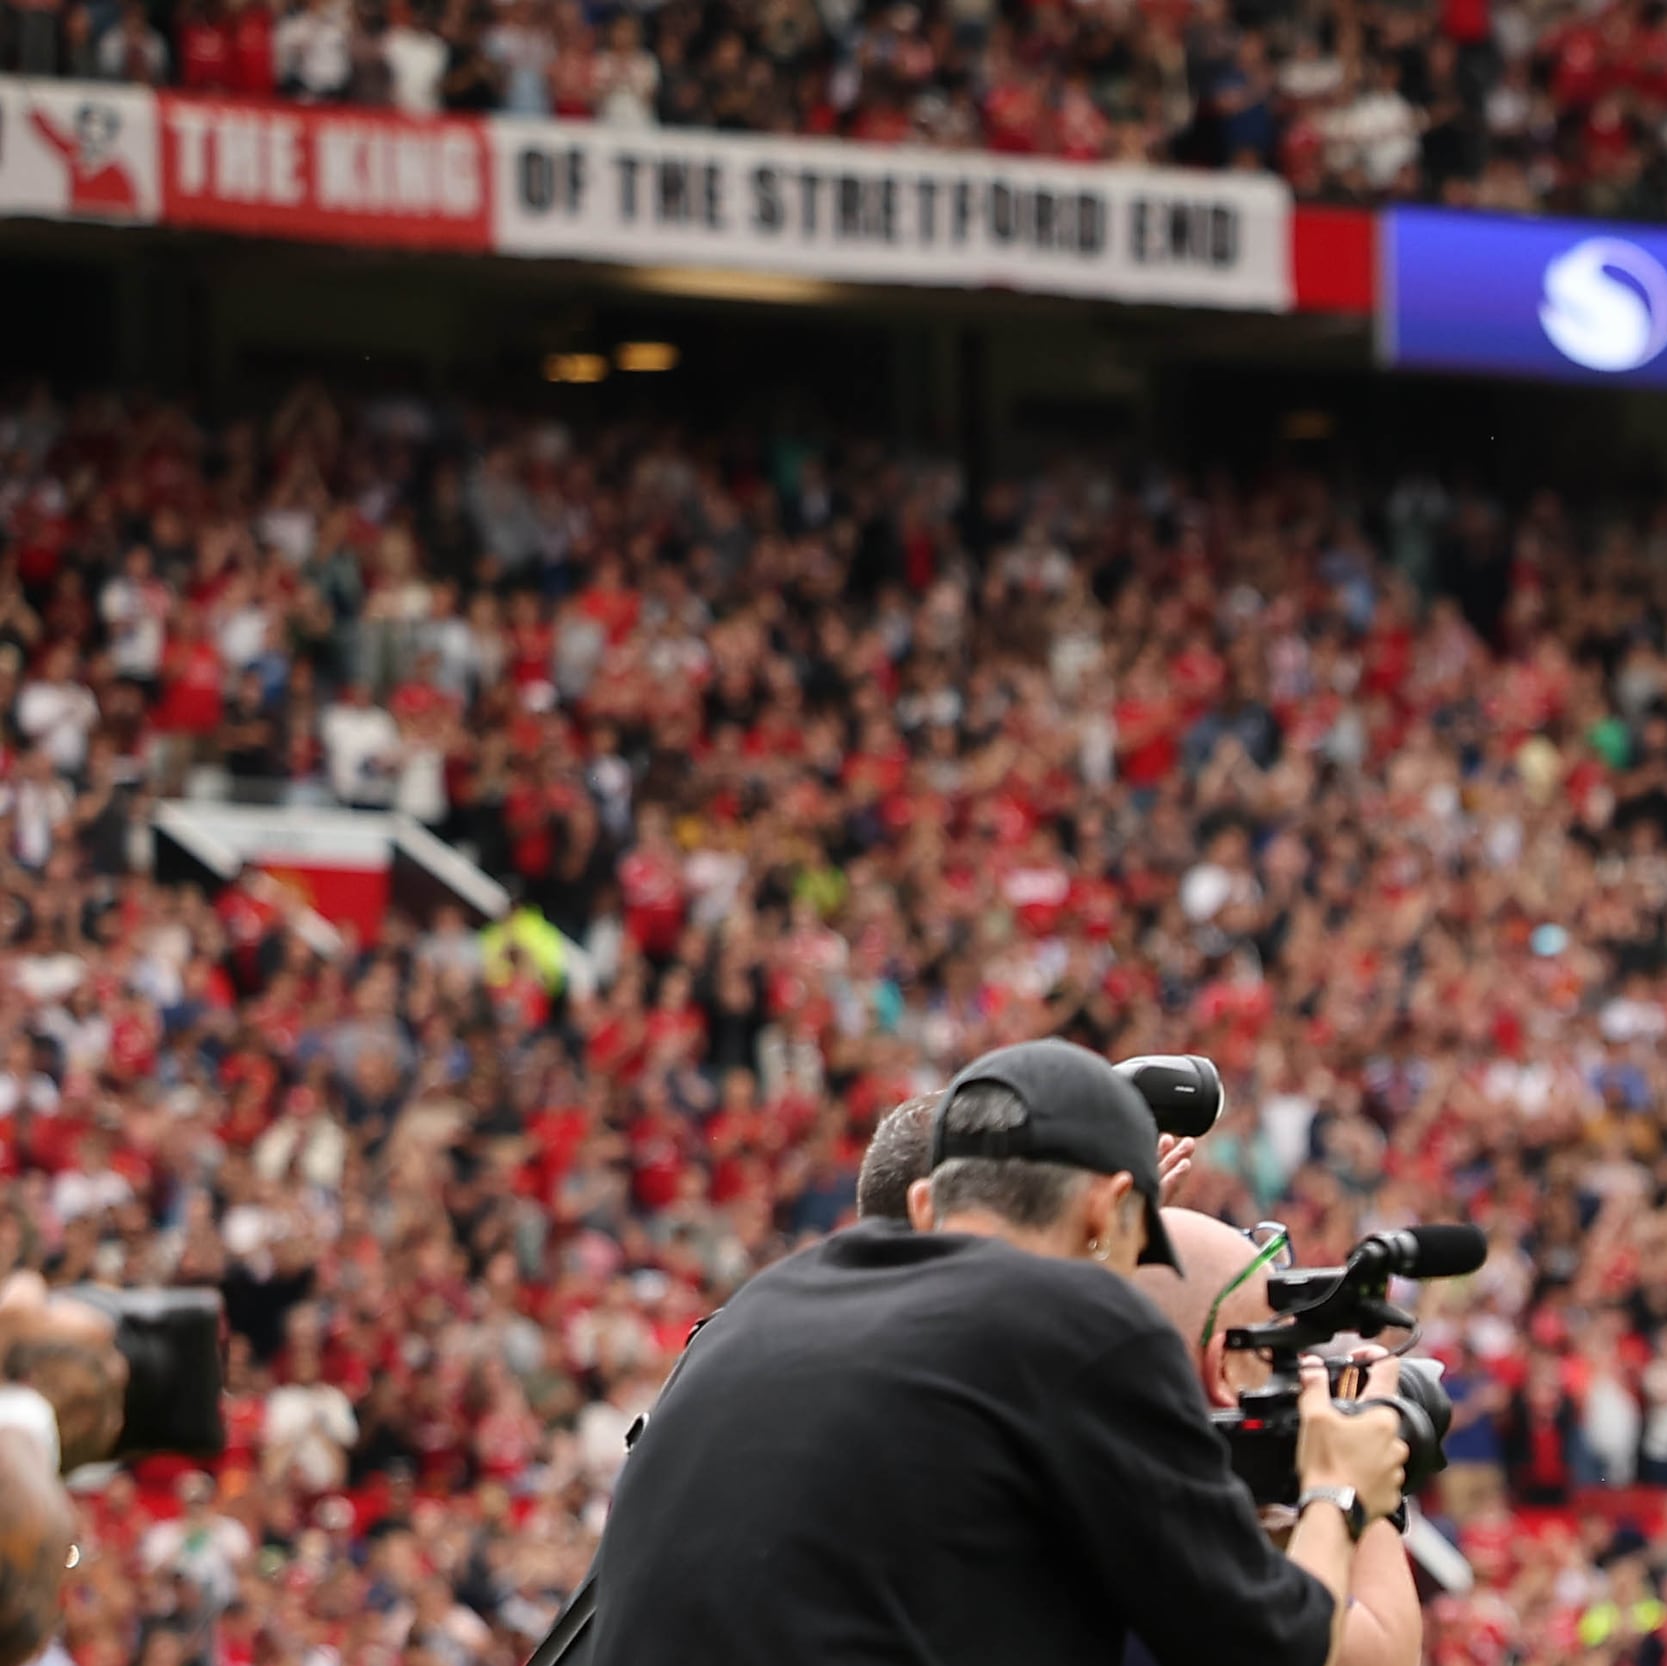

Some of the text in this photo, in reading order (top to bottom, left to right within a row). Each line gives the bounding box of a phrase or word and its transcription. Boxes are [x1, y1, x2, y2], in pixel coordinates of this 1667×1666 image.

[169, 102, 484, 219] THE KING
[516, 147, 1240, 268] OF THE STRETFORD END
